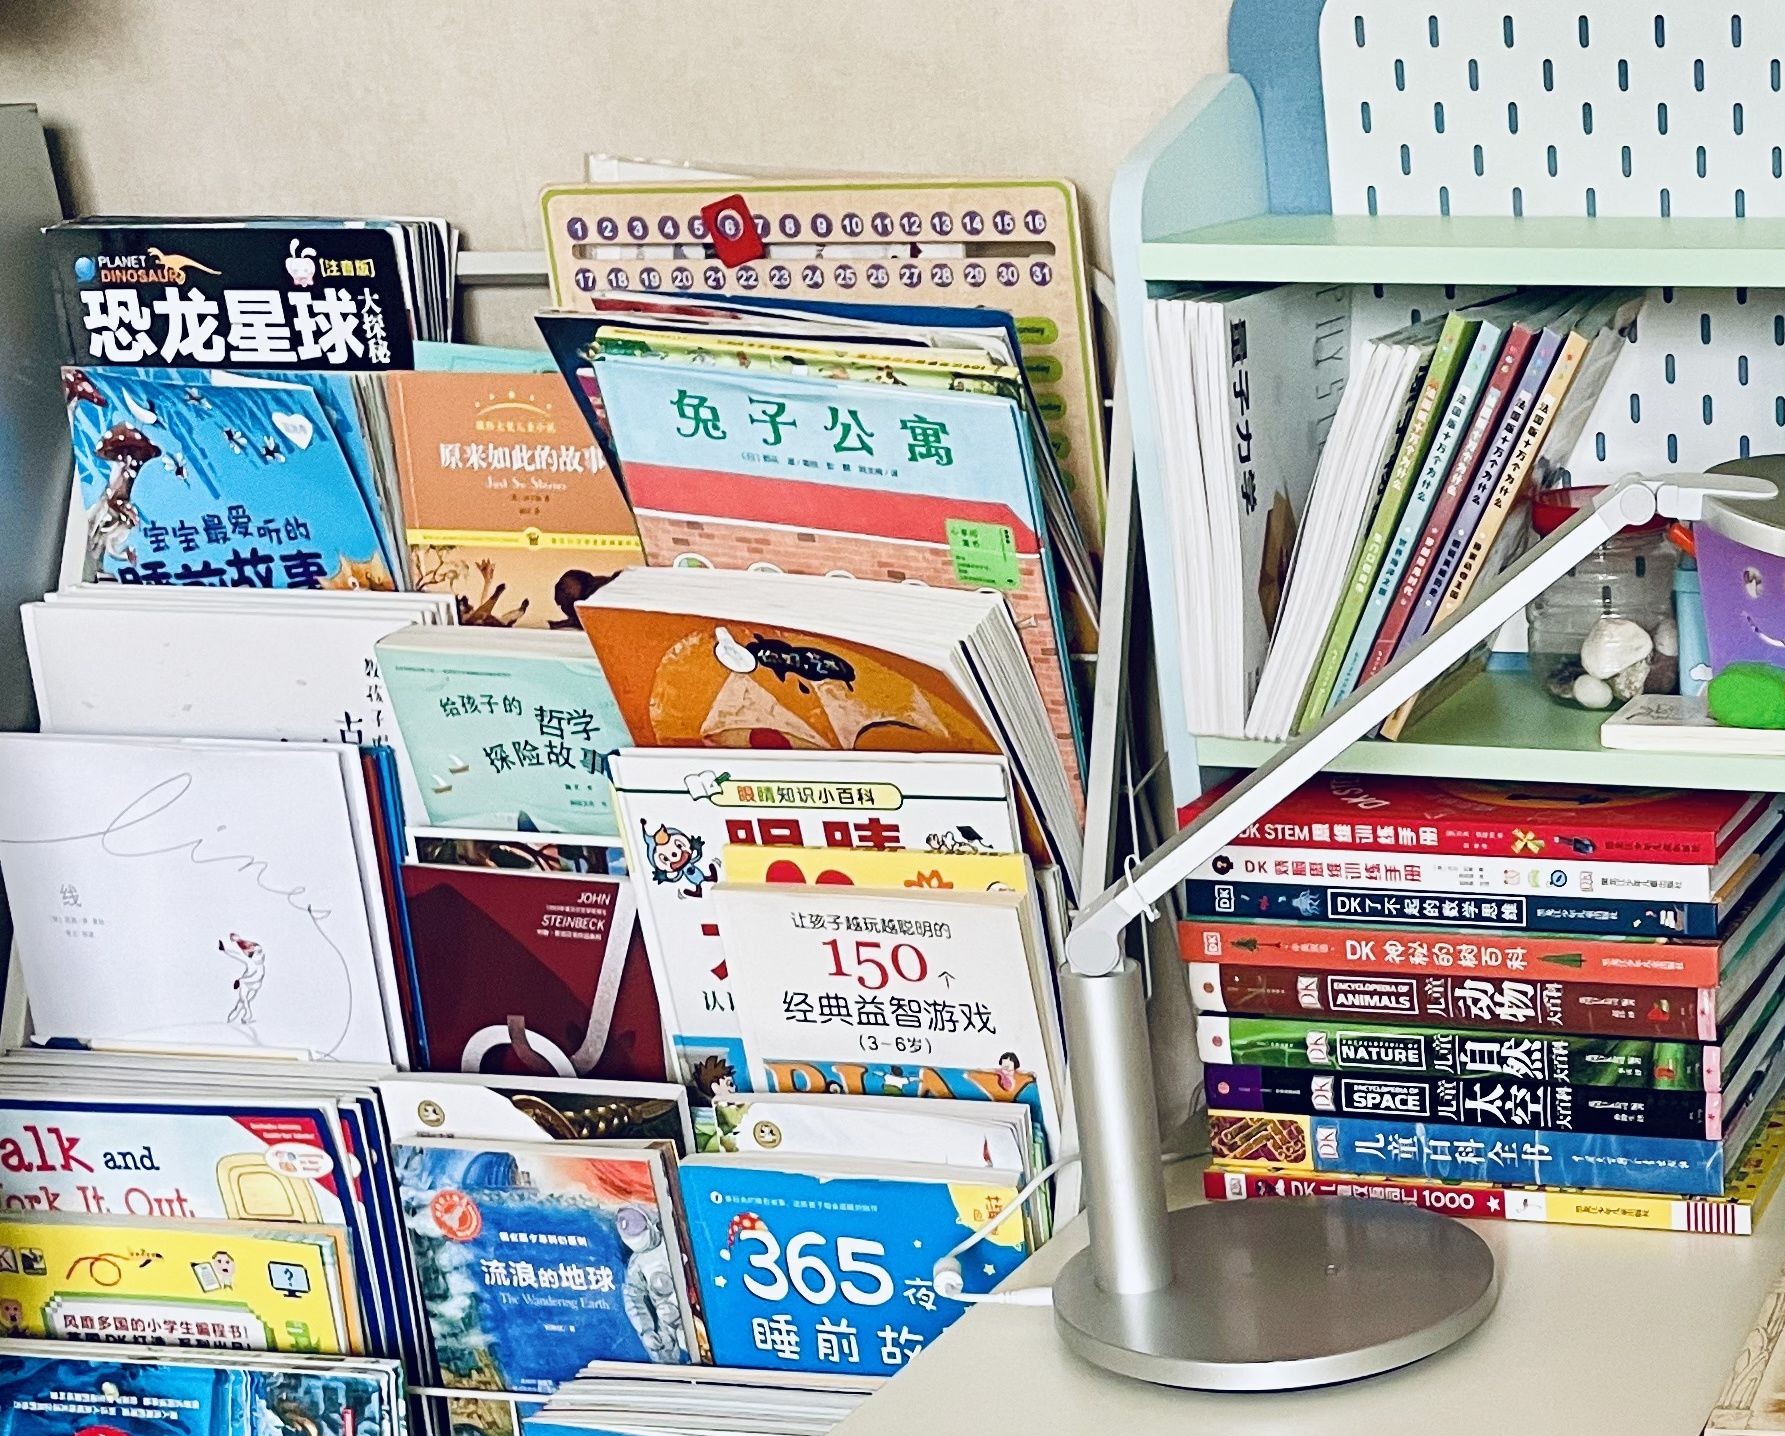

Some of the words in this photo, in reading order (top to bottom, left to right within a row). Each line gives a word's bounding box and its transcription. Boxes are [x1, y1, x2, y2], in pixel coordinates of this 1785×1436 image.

[575, 222, 582, 237] 1
[602, 222, 613, 237] 2
[633, 221, 643, 236] 3
[664, 221, 673, 236] 4
[694, 221, 704, 235] 5
[725, 219, 734, 235] 6
[754, 219, 763, 234] 7
[785, 219, 794, 233] 8
[817, 218, 827, 233] 9
[842, 217, 862, 233] 10
[874, 218, 892, 232] 11
[902, 217, 921, 231] 12
[933, 216, 951, 231] 13
[964, 215, 982, 230] 14
[995, 215, 1013, 230] 15
[1025, 215, 1045, 229] 16
[97, 256, 147, 268] PLANET
[101, 269, 184, 284] DINOSAUR
[576, 272, 595, 287] 17
[608, 272, 627, 286] 18
[641, 271, 659, 286] 19
[673, 271, 692, 285] 20
[705, 271, 723, 285] 21
[736, 271, 757, 285] 22
[771, 270, 790, 285] 23
[802, 269, 823, 284] 24
[835, 269, 856, 284] 25
[868, 269, 888, 283] 26
[901, 269, 920, 284] 27
[933, 268, 952, 283] 28
[965, 268, 984, 283] 29
[998, 268, 1017, 282] 30
[1032, 267, 1050, 282] 31
[80, 287, 367, 364] 恐龙星球
[357, 288, 391, 364] 大探秘
[670, 388, 954, 467] 兔子公寓
[439, 442, 608, 475] 原来如此的故事
[1416, 385, 1472, 503] 法国版十万个为什么
[1472, 390, 1533, 506] 法国版十万个为什么
[1493, 393, 1556, 510] 法国版十万个为什么
[143, 505, 312, 553] 宝宝最爱听的
[439, 695, 523, 718] 给孩子的
[534, 705, 601, 741] 哲学
[737, 785, 875, 806] 眼睛知识小百科
[1245, 861, 1268, 875] DK
[577, 892, 611, 905] JOHN
[541, 914, 606, 931] STEINBECK
[790, 911, 952, 938] 让孩子越玩越聪明的
[822, 939, 929, 990] 150
[937, 971, 957, 989] 个
[1345, 939, 1376, 961] DK
[1300, 978, 1319, 1007] DK
[1333, 982, 1396, 994] ENCYCLOPEDIA
[1397, 984, 1410, 994] OF
[1336, 992, 1411, 1009] ANIMALS
[1454, 979, 1537, 1023] 动物
[782, 989, 997, 1035] 经典益智游戏
[1308, 1033, 1329, 1062] DK
[1341, 1046, 1420, 1063] NATURE
[1459, 1038, 1543, 1080] 自然
[1314, 1078, 1334, 1108] DK
[1352, 1092, 1421, 1110] SPACE
[1465, 1082, 1545, 1126] 太空
[0, 1125, 94, 1174] alk
[103, 1146, 160, 1172] and
[1318, 1128, 1337, 1156] DK
[1355, 1132, 1552, 1168] 儿童百科全书
[0, 1186, 62, 1212] ork
[77, 1186, 111, 1214] It
[1423, 1190, 1474, 1209] 1000
[480, 1258, 616, 1293] 流浪的地球
[739, 1230, 895, 1306] 365
[903, 1277, 938, 1312] 夜
[500, 1292, 519, 1304] The
[523, 1293, 579, 1310] Wandering
[580, 1298, 611, 1310] Earth
